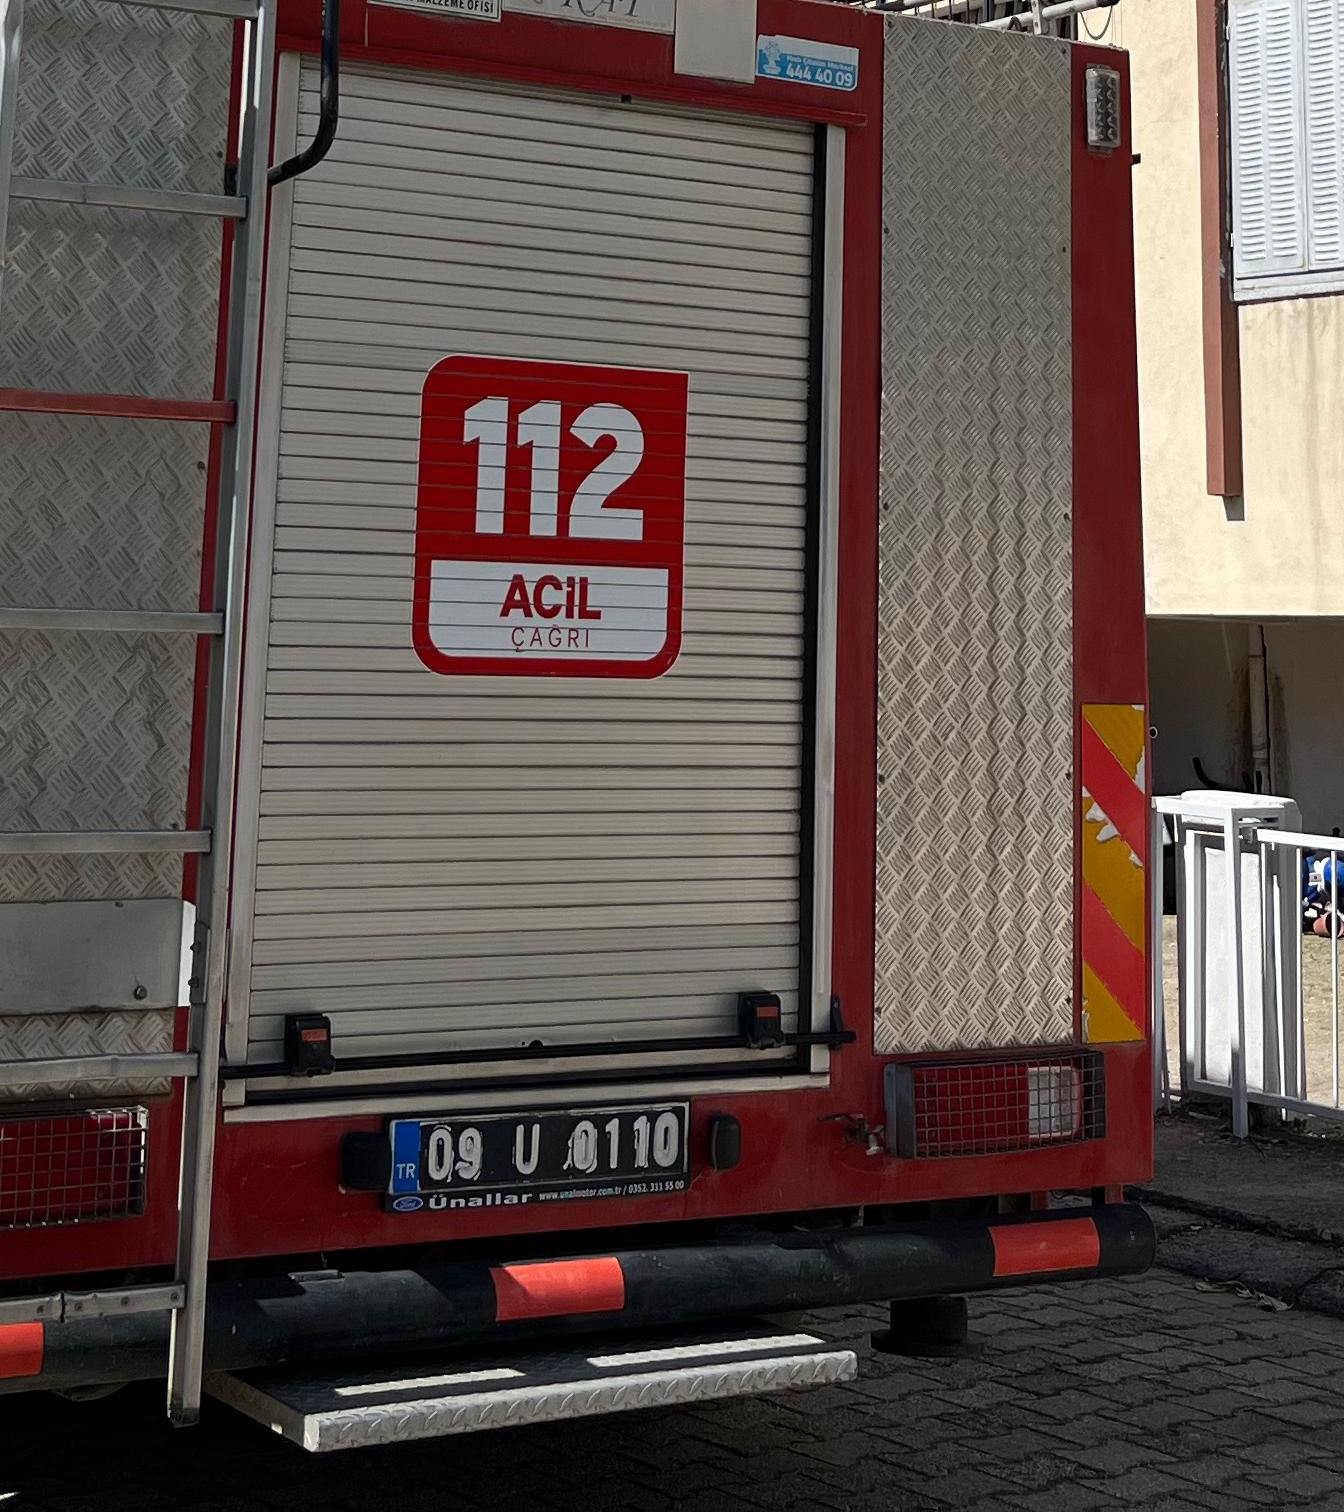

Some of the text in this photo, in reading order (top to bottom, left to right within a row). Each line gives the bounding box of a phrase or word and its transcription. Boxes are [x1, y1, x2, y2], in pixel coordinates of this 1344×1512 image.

[786, 64, 854, 87] 444 40 09
[463, 396, 645, 541] 112
[499, 574, 602, 620] ACİL
[511, 623, 590, 653] ÇAĞRI
[427, 1124, 484, 1182] 09
[514, 1122, 541, 1175] U
[396, 1162, 416, 1181] TR
[429, 1191, 533, 1209] Ünallar
